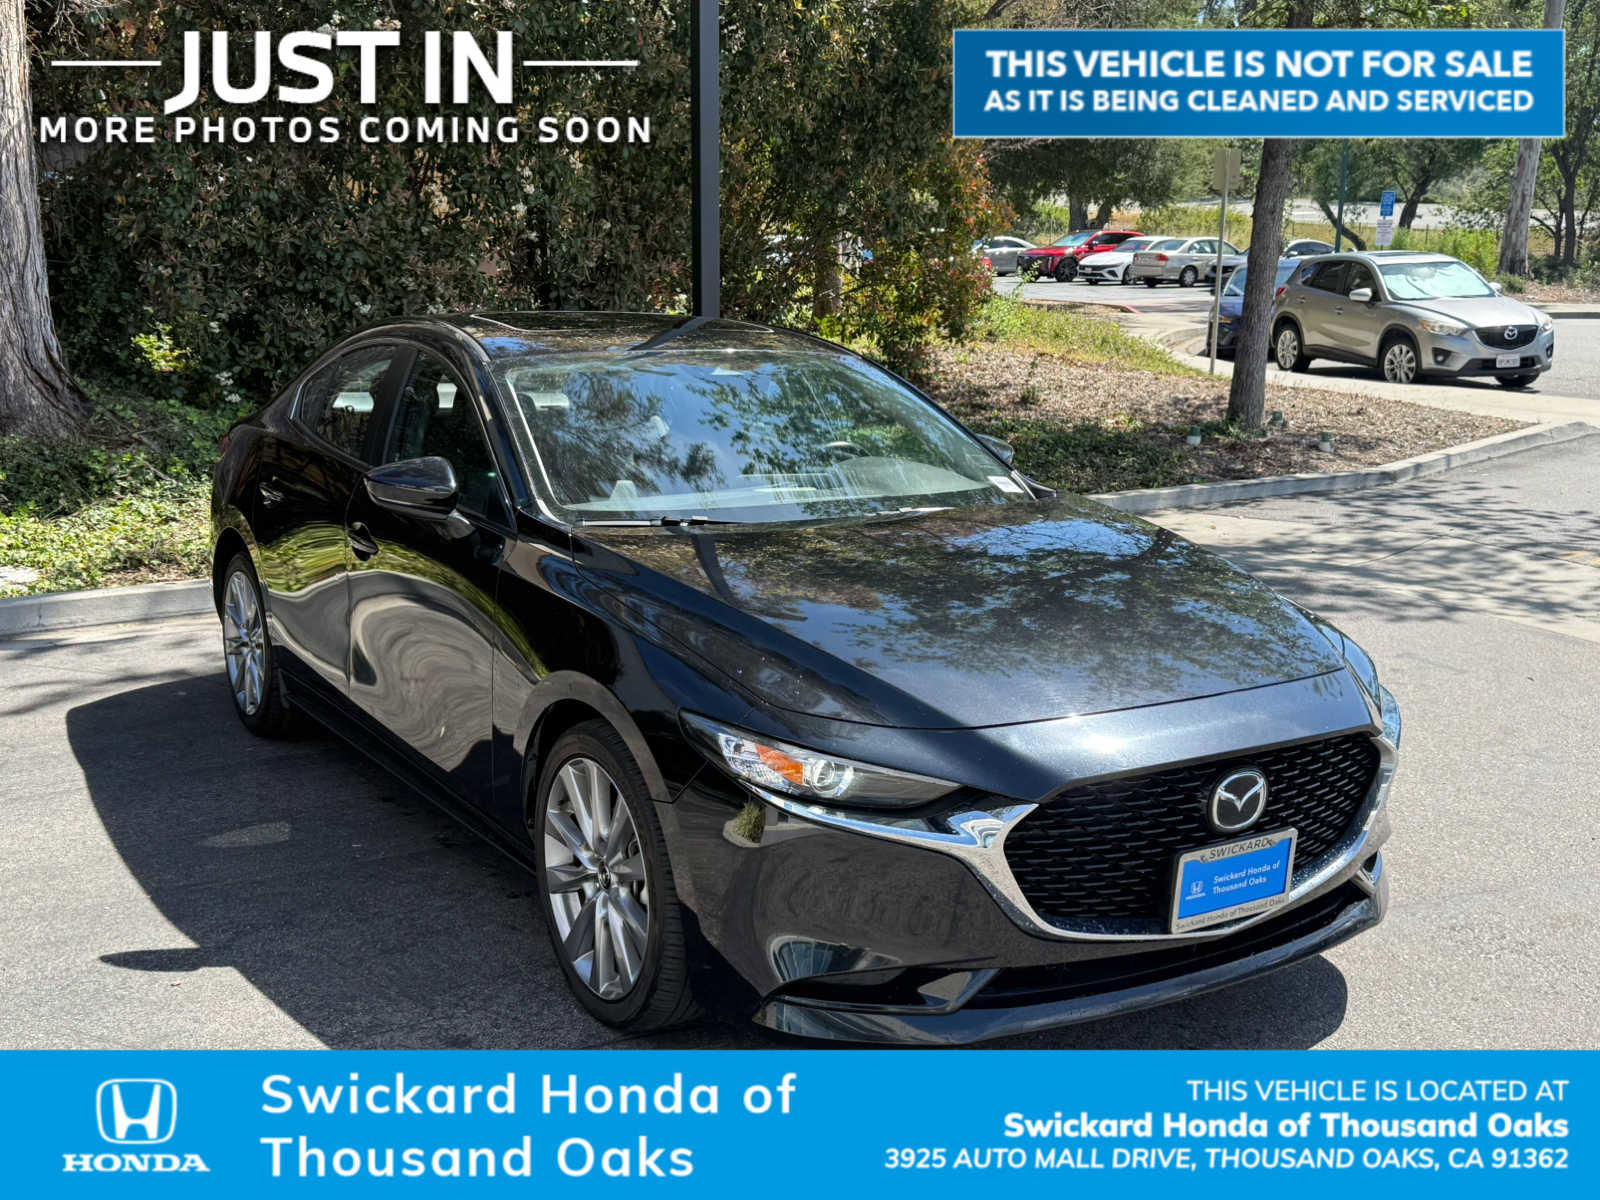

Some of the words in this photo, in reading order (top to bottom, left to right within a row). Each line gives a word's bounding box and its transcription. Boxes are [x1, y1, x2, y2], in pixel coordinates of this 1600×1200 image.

[1209, 838, 1270, 860] SWICKARD
[1213, 868, 1247, 883] Swickard
[1247, 864, 1271, 877] Honda
[1273, 860, 1280, 870] of
[1212, 881, 1248, 895] Thousand
[1249, 876, 1267, 887] Oaks
